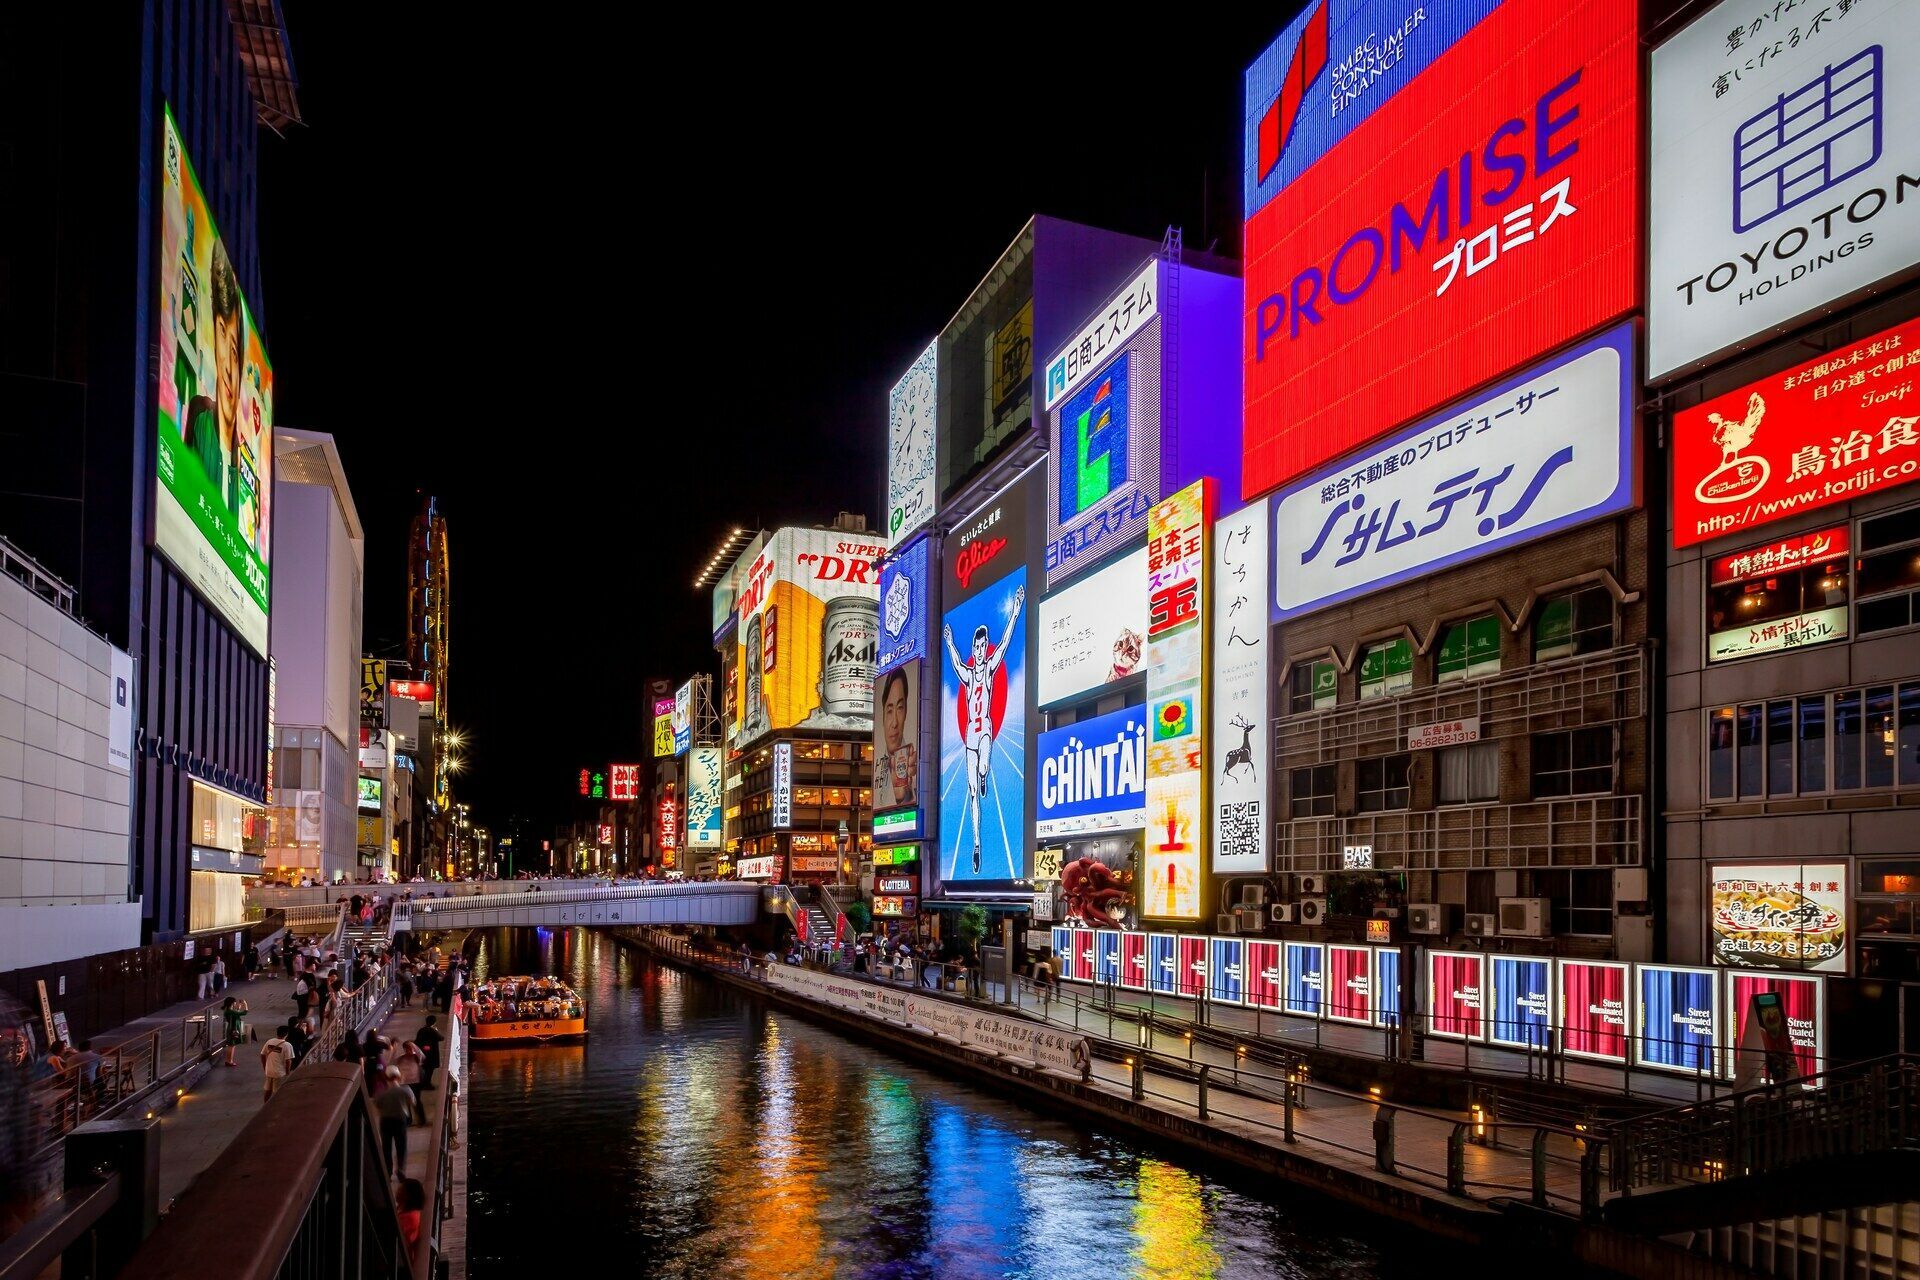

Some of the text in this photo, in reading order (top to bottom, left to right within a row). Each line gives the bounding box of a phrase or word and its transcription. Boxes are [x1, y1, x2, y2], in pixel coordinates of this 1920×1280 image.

[1331, 8, 1427, 100] CONSUMER
[1331, 32, 1377, 85] SMBC
[1331, 42, 1404, 118] FINANCE
[1256, 66, 1584, 361] PROMISE
[1432, 177, 1578, 298] プロミス
[1738, 232, 1875, 306] HOLDINGS
[1068, 282, 1152, 382] 日商エステム
[1783, 335, 1902, 391] まだ観ぬ未来は
[1860, 380, 1913, 408] Toriji
[1320, 386, 1560, 504] 総合不動産のプロデューサー
[905, 488, 924, 519] ピップ
[960, 508, 1002, 547] おいしさと健康
[1149, 522, 1201, 558] 日本一
[836, 542, 887, 557] SUPER
[1149, 535, 1201, 574] 安売王
[1149, 559, 1201, 591] スーパー
[1148, 577, 1199, 637] 玉
[848, 667, 866, 679] 生
[656, 721, 664, 754] バイト
[1410, 730, 1477, 749] 06-6262-1313
[1422, 722, 1463, 737] 広告募集
[1041, 720, 1146, 810] CHINTAI
[1344, 845, 1373, 862] BAR
[886, 880, 910, 890] LOTTERIA
[1717, 881, 1839, 892] 昭和四十六年創業
[1367, 922, 1389, 932] BAR
[1722, 940, 1836, 957] 元祖スタミナ丼
[1603, 999, 1622, 1009] Street
[1688, 1007, 1710, 1018] Street
[1787, 1017, 1813, 1028] Street
